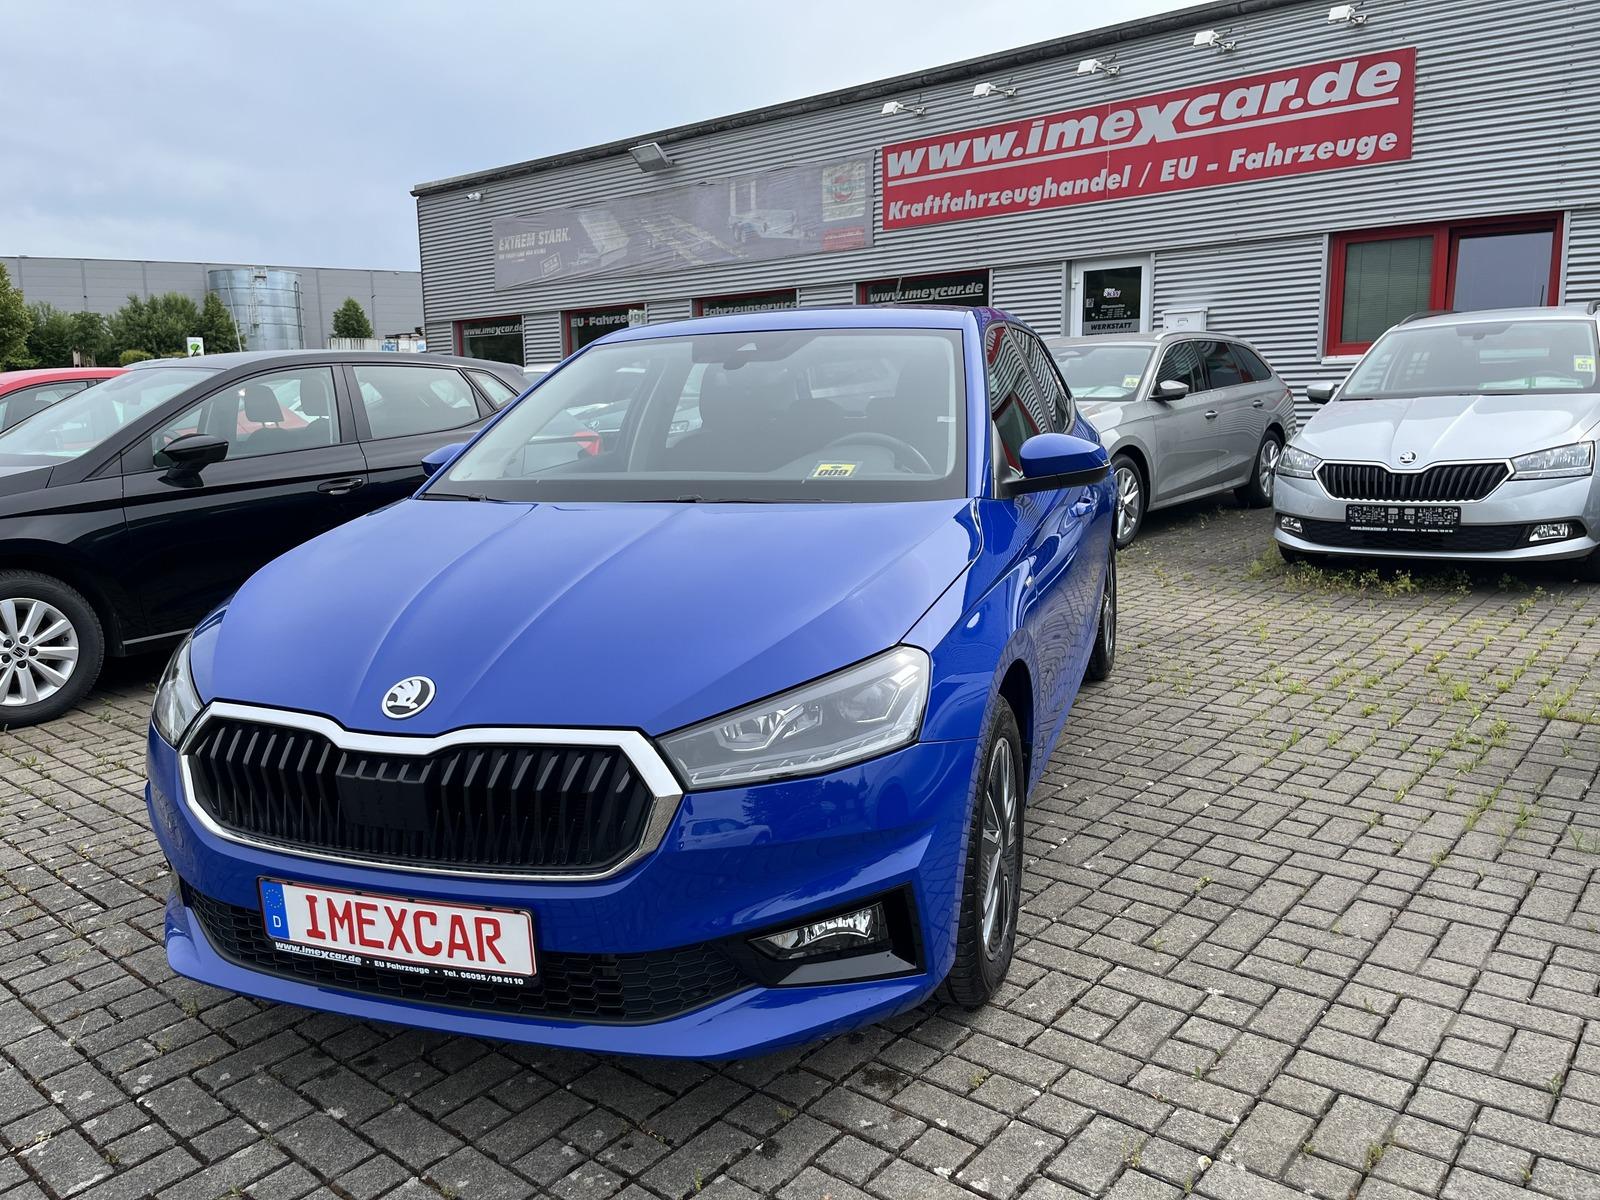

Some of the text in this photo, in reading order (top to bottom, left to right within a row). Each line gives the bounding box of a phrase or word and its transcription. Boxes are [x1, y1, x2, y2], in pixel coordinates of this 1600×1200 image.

[887, 60, 1402, 179] www.imexcar.de
[888, 165, 1132, 221] Kraftfahrzeughandel
[1160, 155, 1199, 182] EU
[1228, 132, 1398, 173] Fahrzeuge
[498, 232, 536, 251] EXTREM
[870, 281, 984, 303] www.imexcar.de
[703, 301, 799, 317] Fahrzeugservice
[1090, 321, 1132, 331] WERKSTATT
[272, 894, 506, 964] D IMEXCAR
[274, 941, 362, 965] www.imexcar.de
[374, 960, 385, 968] EU
[386, 961, 430, 974] Fahrzeuge
[443, 969, 459, 978] Tel.
